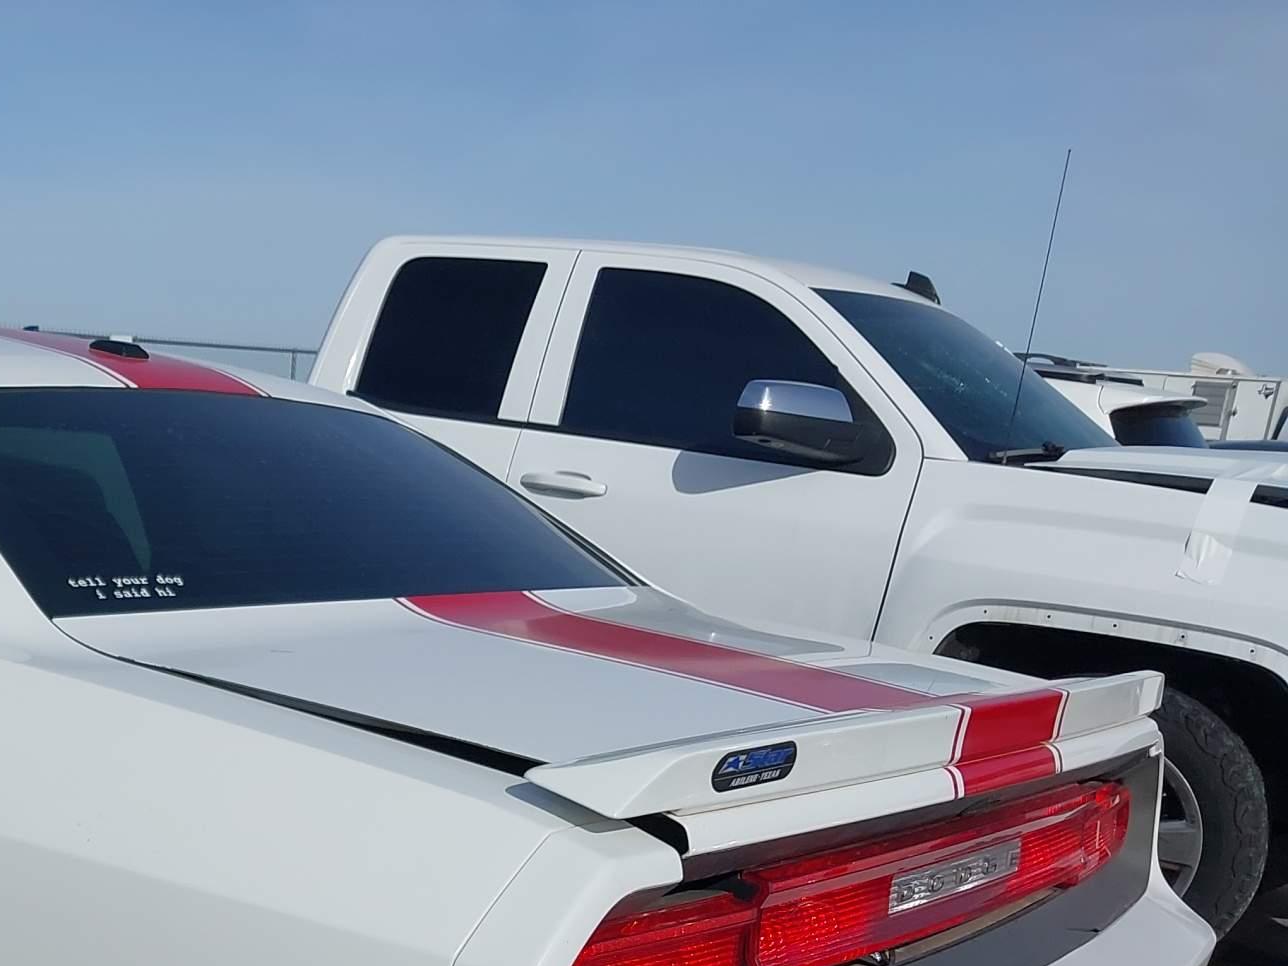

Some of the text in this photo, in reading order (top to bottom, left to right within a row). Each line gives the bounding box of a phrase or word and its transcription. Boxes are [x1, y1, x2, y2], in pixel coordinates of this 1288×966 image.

[67, 573, 185, 588] tell your dog
[113, 587, 151, 599] said
[154, 586, 177, 597] hi
